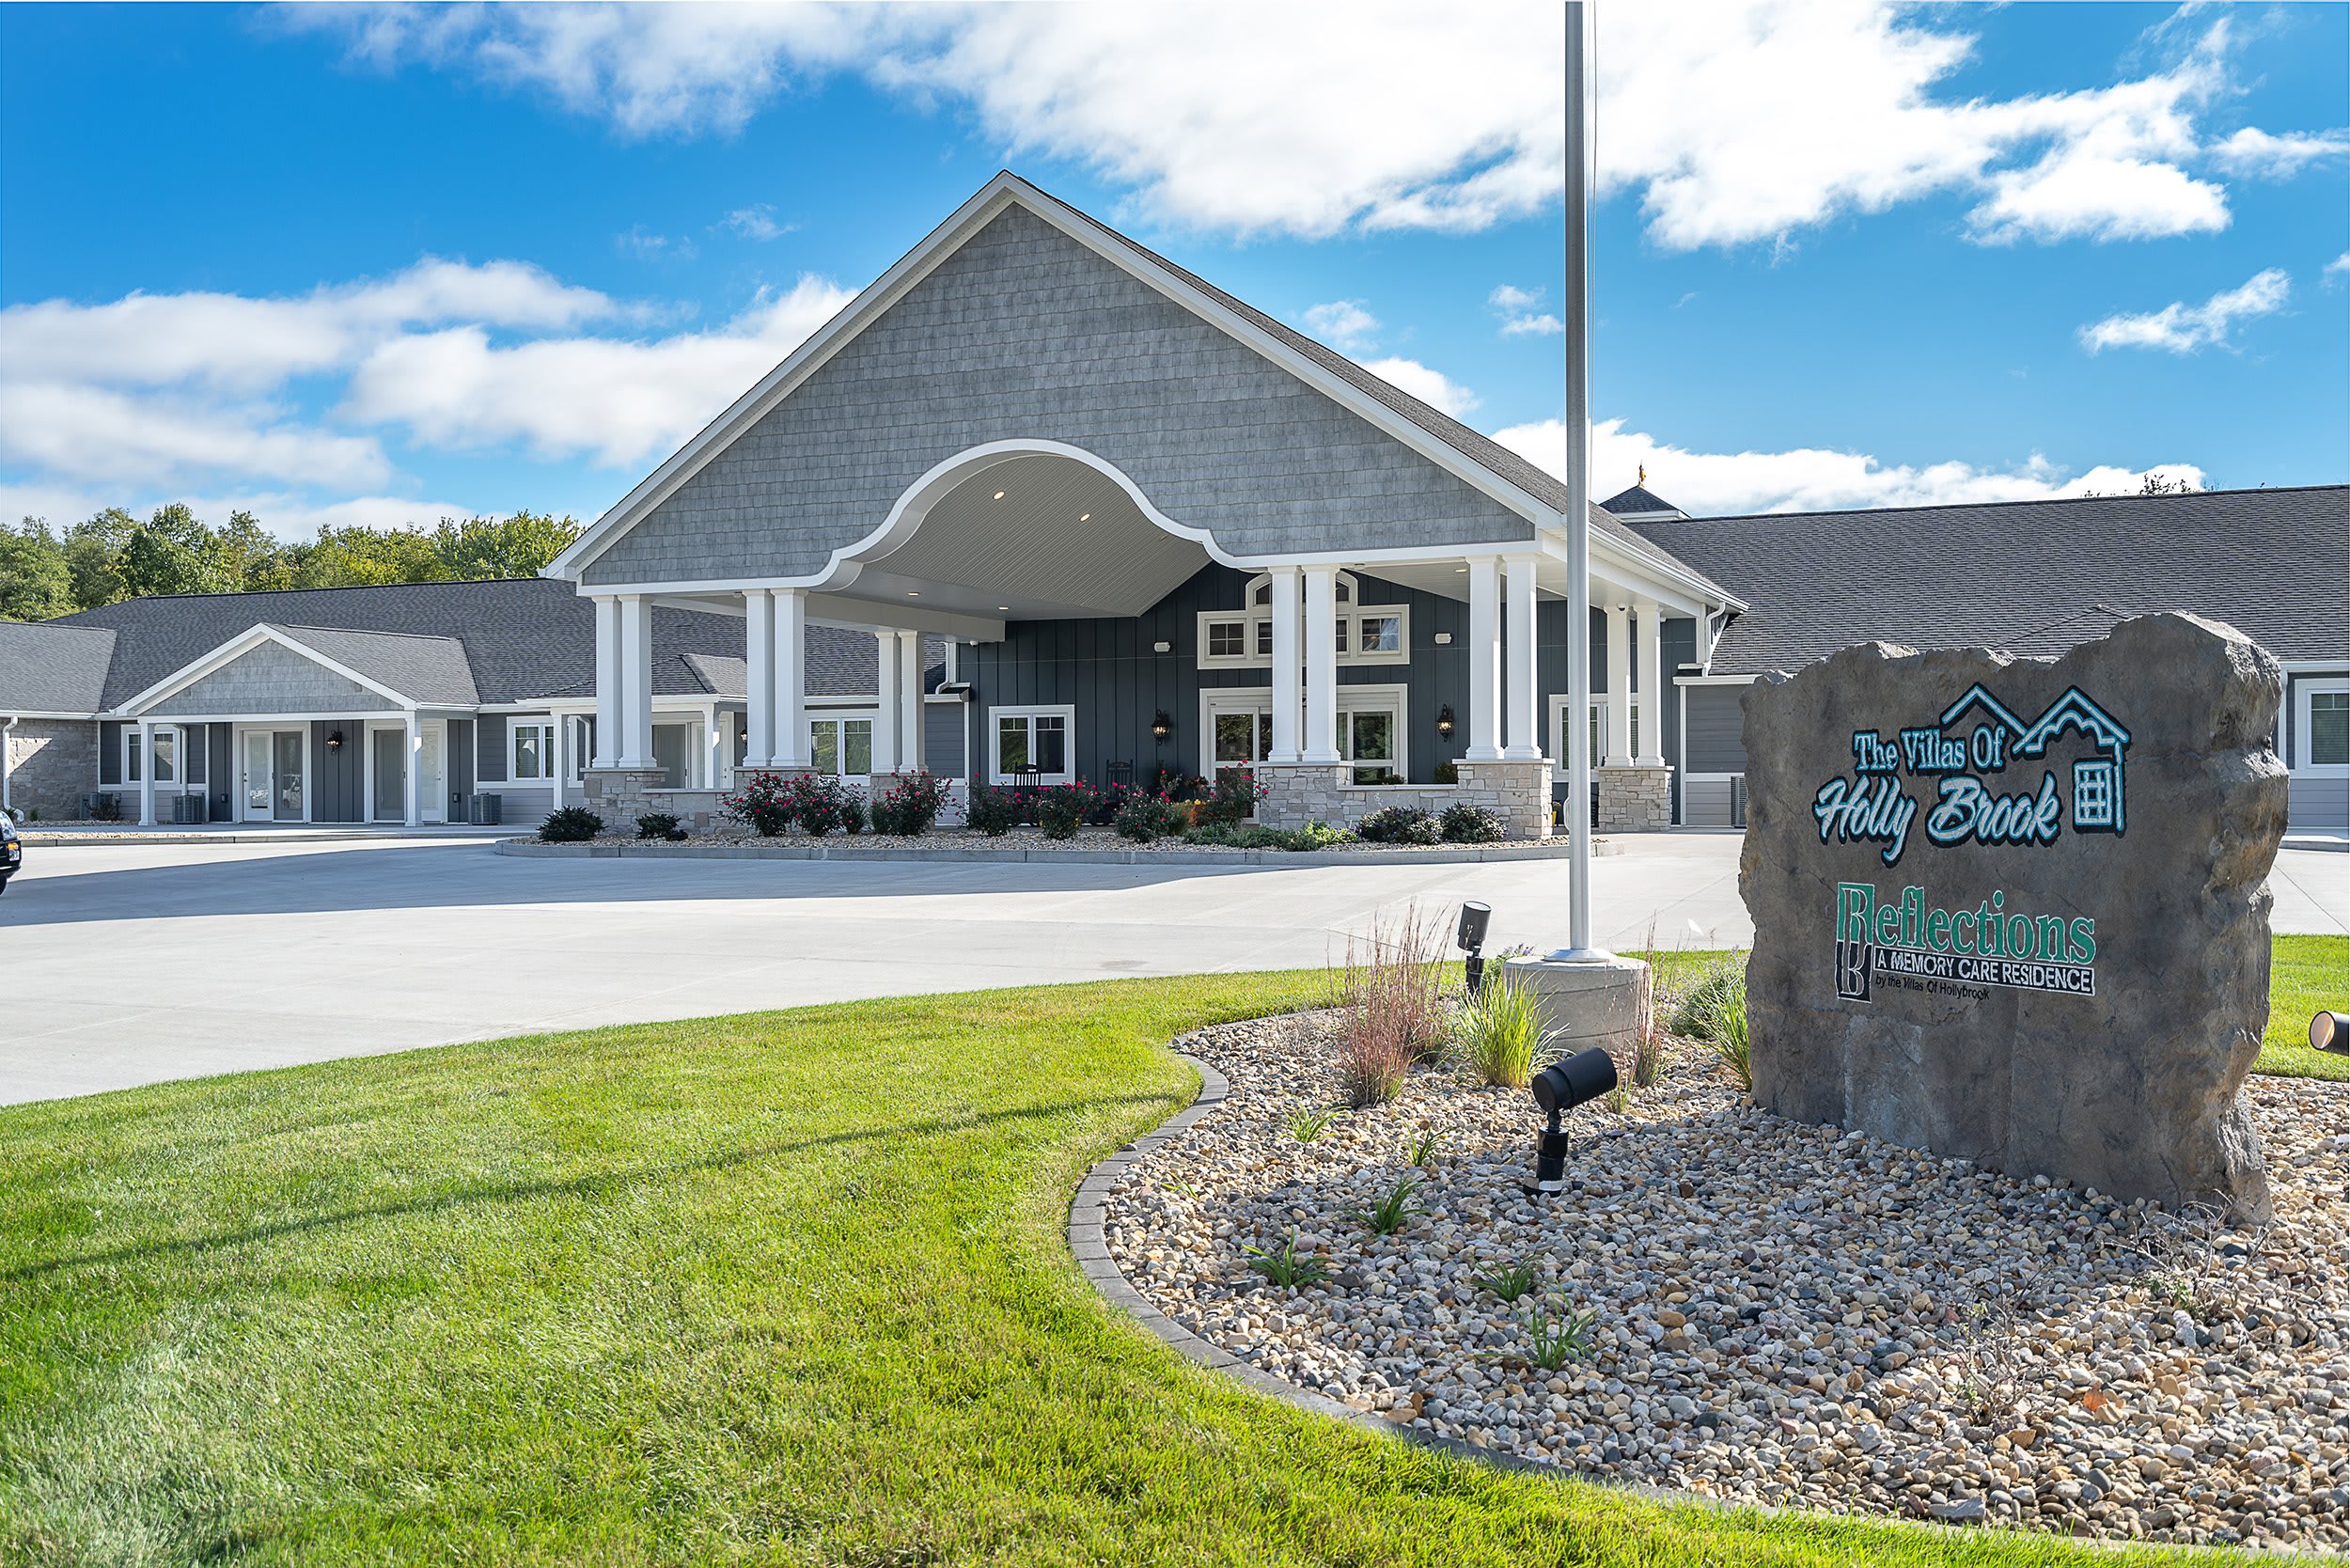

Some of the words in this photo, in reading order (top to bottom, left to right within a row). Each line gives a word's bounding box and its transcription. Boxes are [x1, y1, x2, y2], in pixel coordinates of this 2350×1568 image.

[1854, 731, 1899, 771] The
[1900, 729, 1966, 773] Villas
[1972, 725, 2007, 768] Of
[1814, 774, 1917, 862] Holly
[1926, 773, 2059, 842] Brook
[1837, 882, 2097, 964] Reflections
[1875, 973, 1886, 988] by
[1888, 975, 1902, 988] the
[1903, 977, 1924, 992] Villas
[1926, 980, 1938, 994] Of
[1939, 981, 1990, 1000] Hollybrook
[1877, 949, 1887, 968] A
[1890, 950, 1955, 977] MEMORY
[1957, 958, 1998, 982] CARE
[2001, 963, 2092, 992] RESIDENCE
